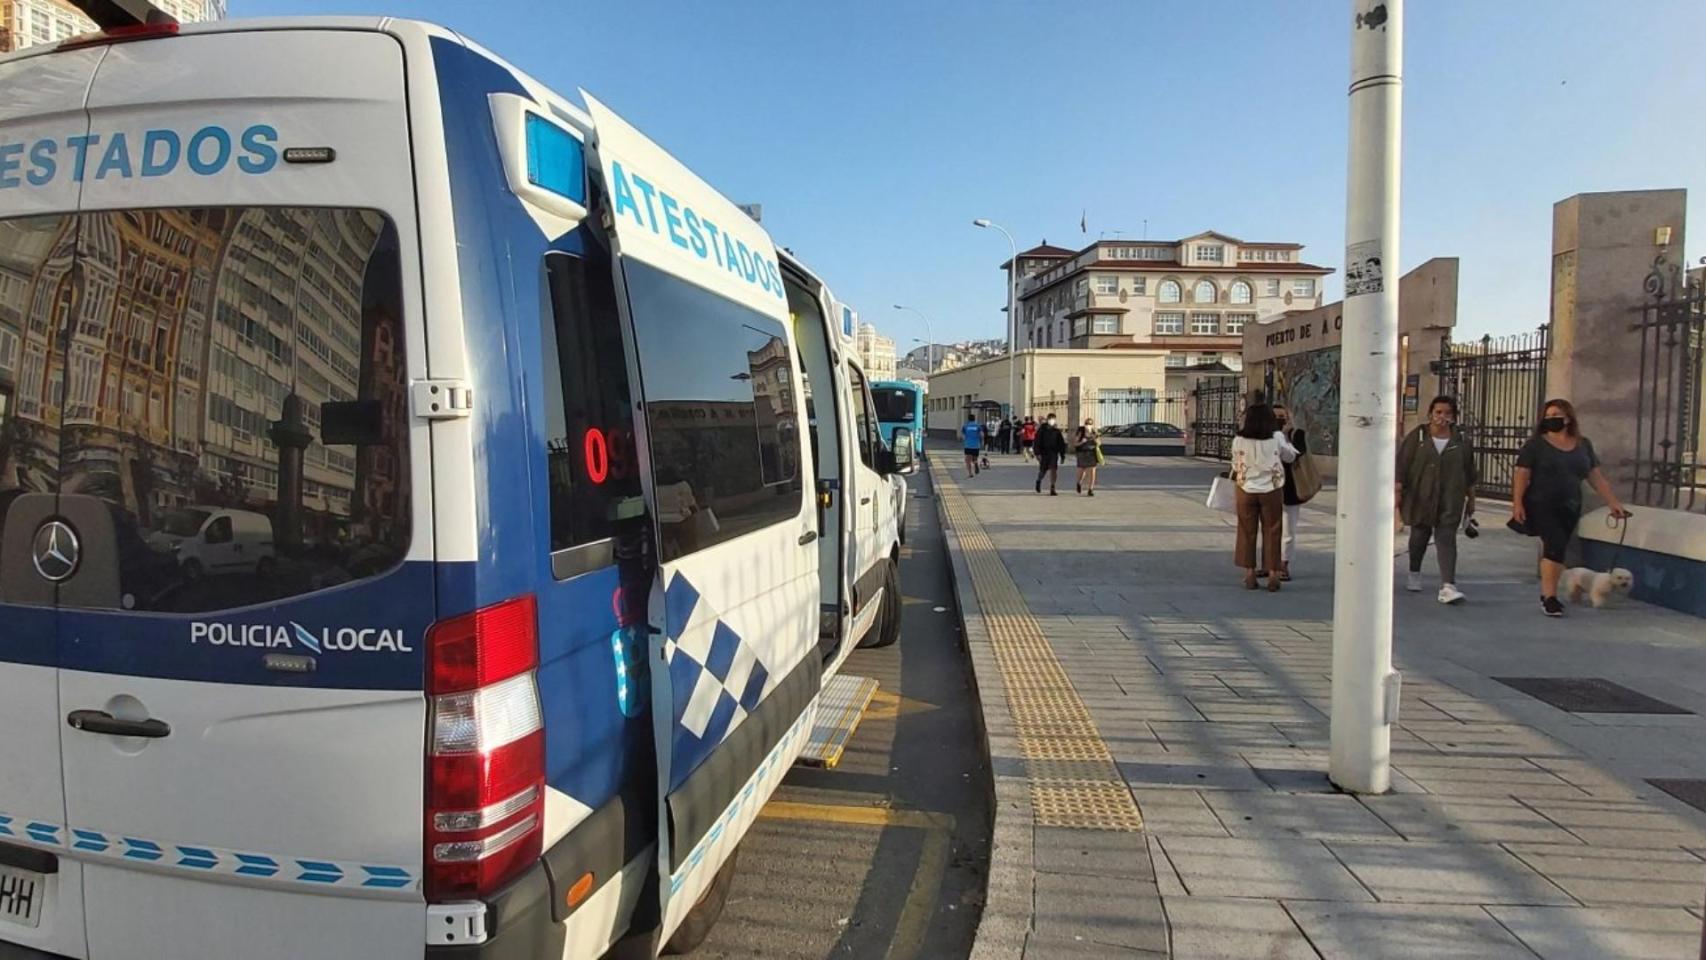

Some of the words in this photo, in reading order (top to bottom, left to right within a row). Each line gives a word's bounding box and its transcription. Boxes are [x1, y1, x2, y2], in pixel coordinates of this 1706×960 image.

[612, 160, 783, 299] ATESTADOS
[1266, 328, 1295, 347] PUERTO
[1300, 324, 1312, 339] DE
[191, 622, 293, 648] POLICIA
[322, 627, 413, 652] LOCAL
